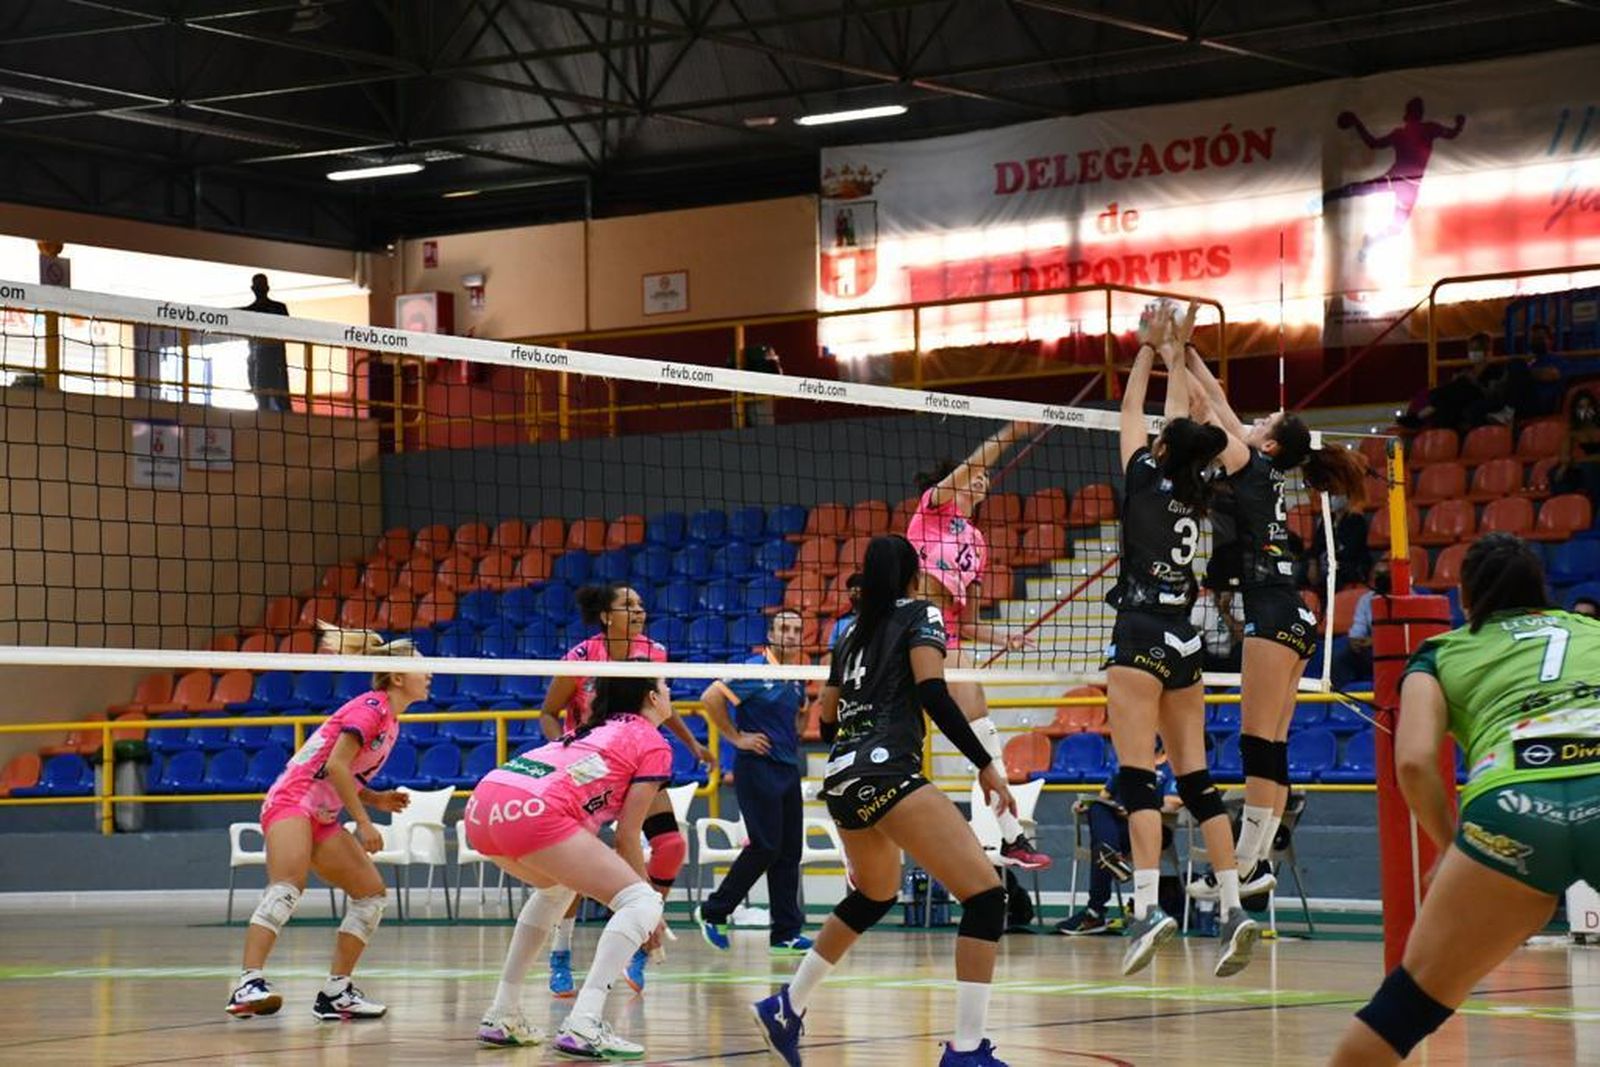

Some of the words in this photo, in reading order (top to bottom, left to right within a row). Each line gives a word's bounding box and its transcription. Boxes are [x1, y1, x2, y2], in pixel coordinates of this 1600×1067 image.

[994, 125, 1276, 195] DELEGACIÓN
[1097, 202, 1139, 234] de
[1011, 244, 1232, 292] DEPORTES
[156, 302, 229, 326] rfevb.com
[344, 326, 408, 347] rfevb.com
[510, 345, 568, 366] rfevb.com
[661, 364, 714, 383] rfevb.com
[798, 380, 847, 397] rfevb.com
[925, 395, 970, 411] rfevb.com
[1043, 407, 1084, 422] rfevb.com
[1170, 516, 1198, 566] 3
[1512, 625, 1570, 683] 7
[842, 648, 867, 690] 4
[856, 787, 897, 822] Divisa
